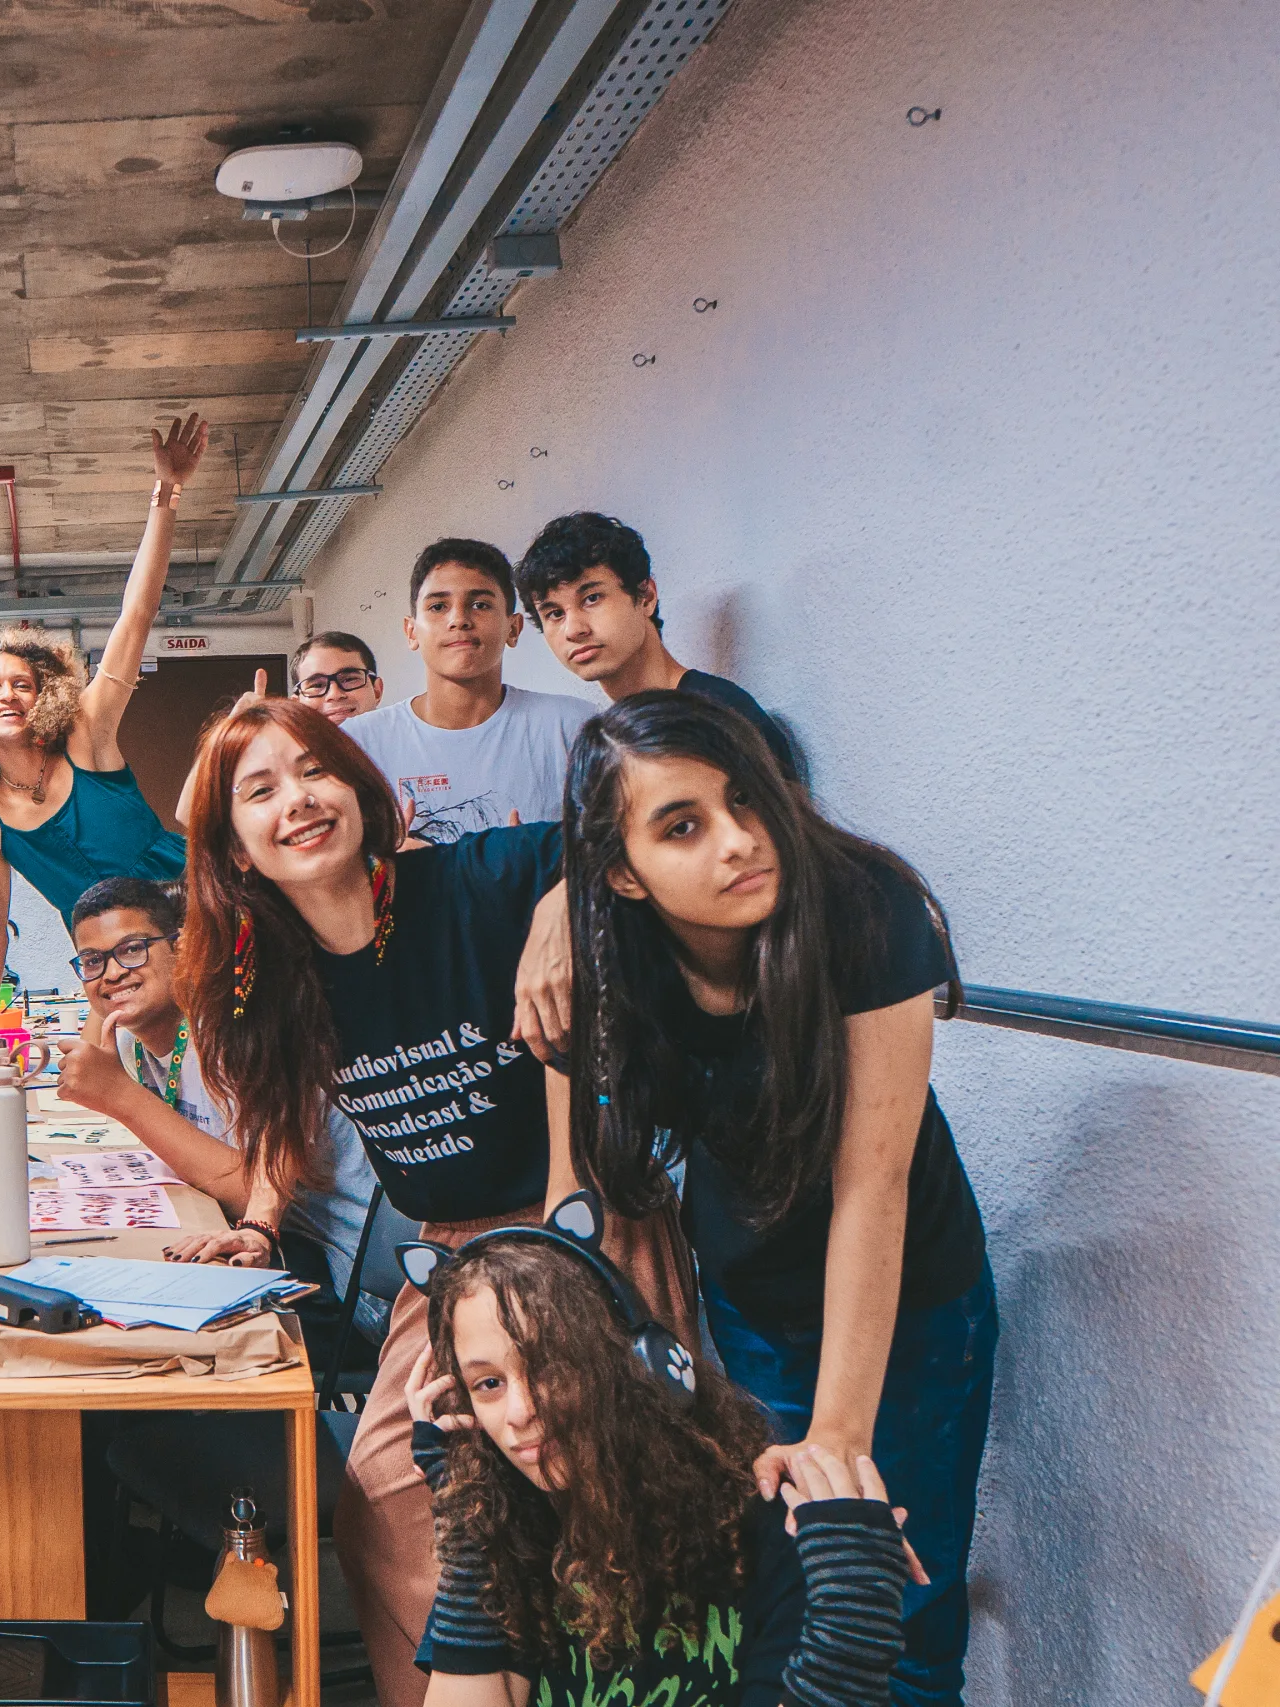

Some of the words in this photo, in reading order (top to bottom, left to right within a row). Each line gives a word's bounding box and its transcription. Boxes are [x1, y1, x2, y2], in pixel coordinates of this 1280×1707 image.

[167, 638, 207, 649] SAÍDA
[459, 1022, 488, 1048] &
[338, 1061, 493, 1114] Comunicação
[496, 1041, 524, 1066] &
[468, 1091, 498, 1114] &
[375, 1133, 475, 1165] onteúdo
